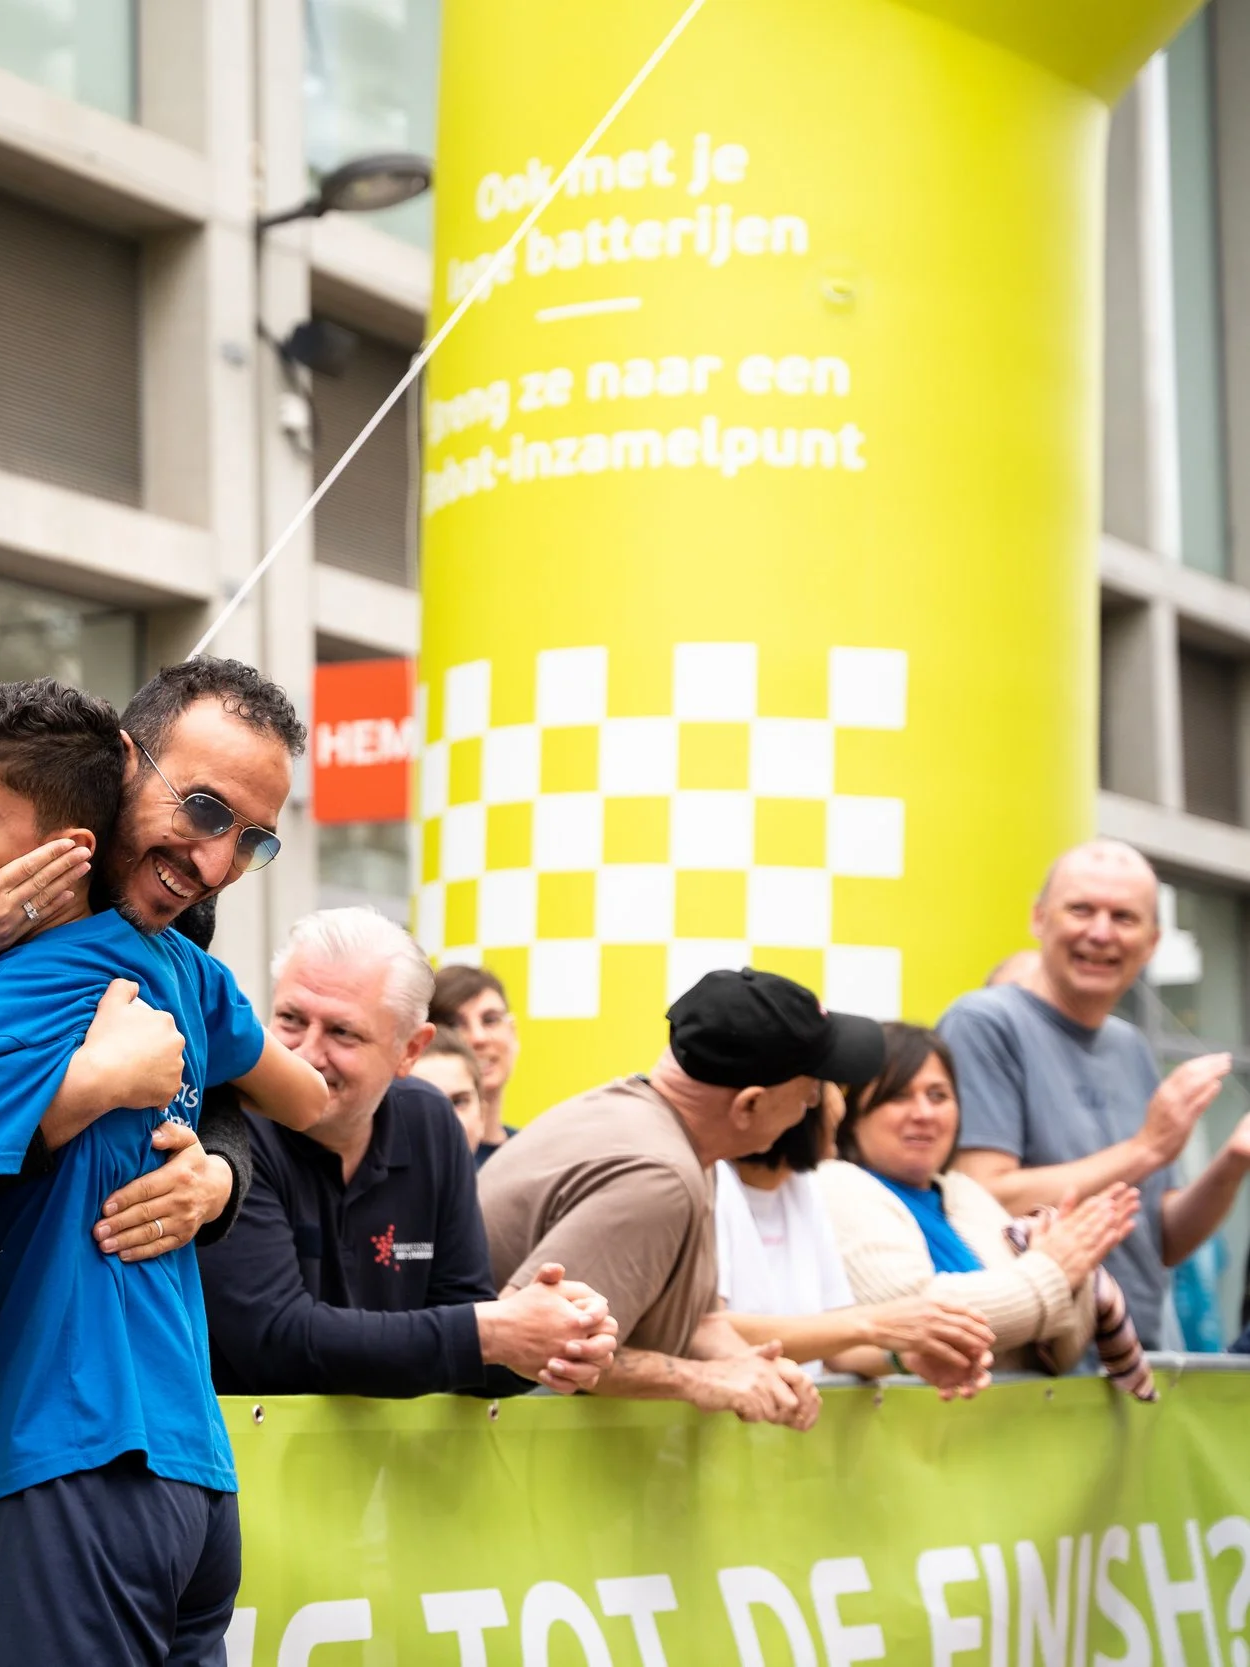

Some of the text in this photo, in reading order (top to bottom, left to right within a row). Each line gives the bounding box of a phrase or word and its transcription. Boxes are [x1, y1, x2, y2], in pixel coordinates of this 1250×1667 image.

[476, 132, 750, 222] Ook met je
[525, 203, 808, 268] batterijen
[517, 364, 574, 412] ze
[586, 354, 723, 401] naar
[737, 354, 851, 397] een
[424, 414, 867, 516] bat-inzamelpunt
[717, 1556, 886, 1667] DE
